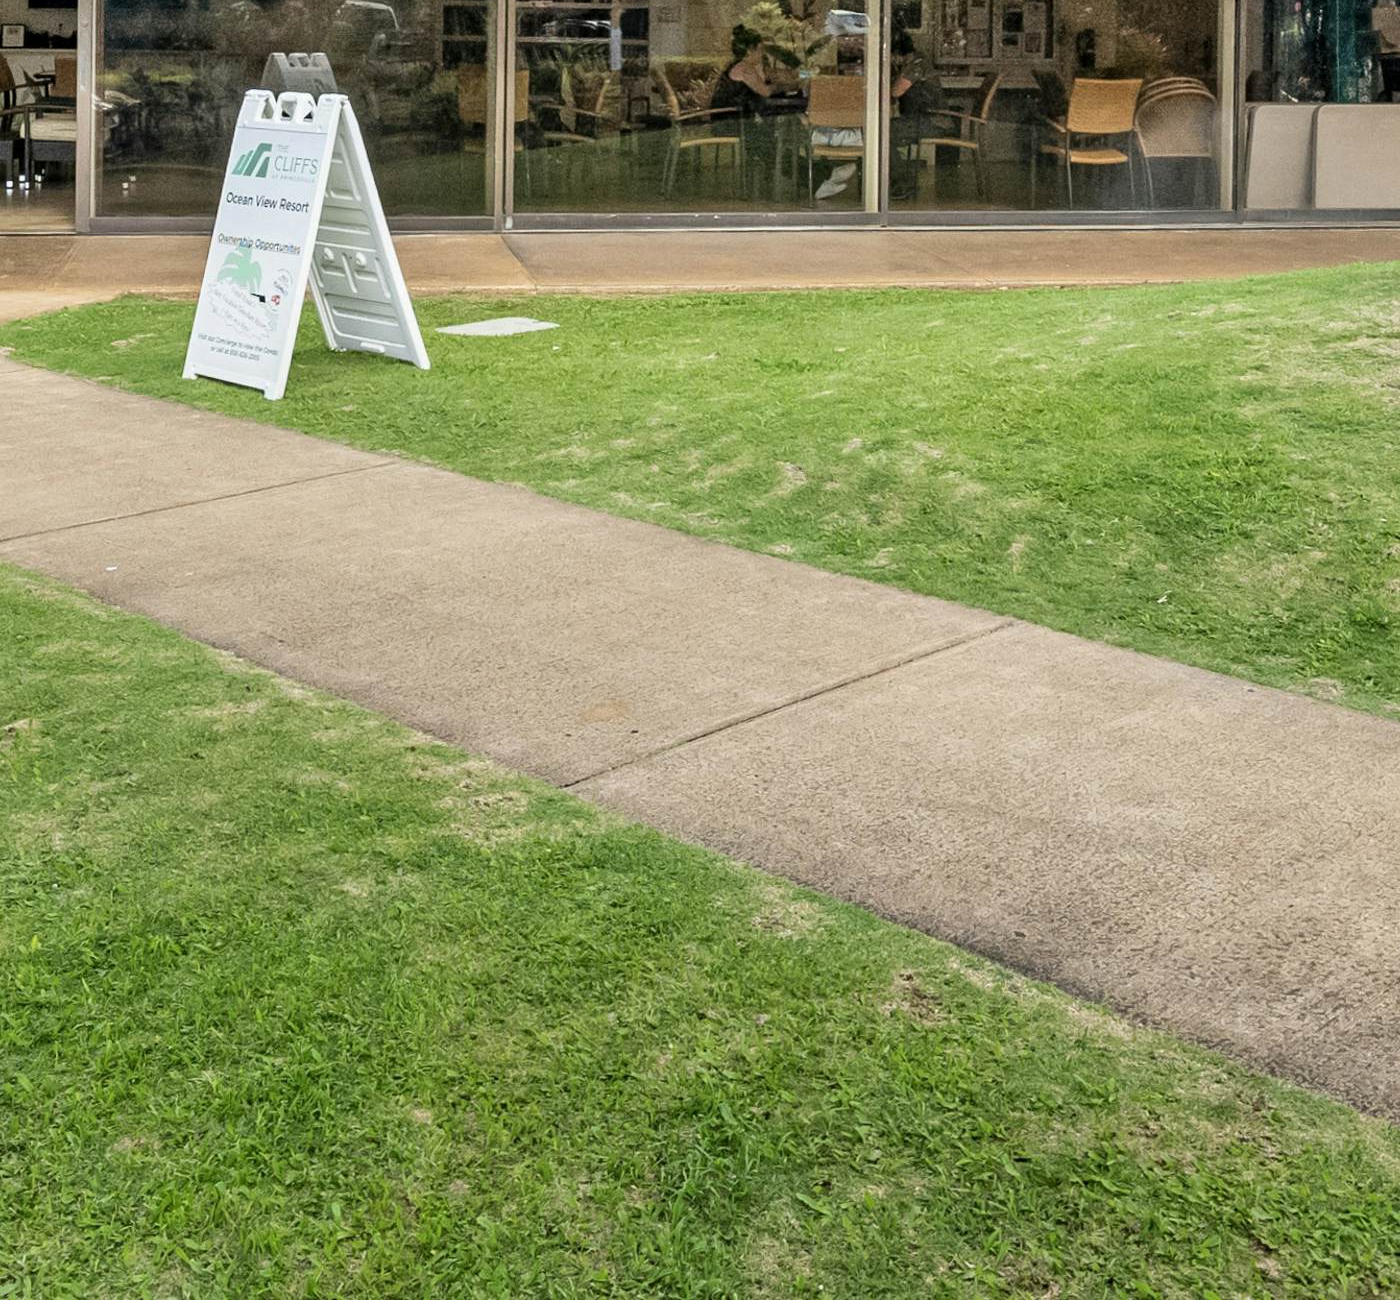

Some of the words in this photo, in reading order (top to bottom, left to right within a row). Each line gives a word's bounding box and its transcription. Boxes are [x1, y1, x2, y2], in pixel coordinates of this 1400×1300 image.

[274, 155, 319, 175] CLIFFS
[226, 191, 254, 206] Ocean
[256, 194, 278, 209] View
[279, 197, 310, 213] Resort
[218, 232, 254, 248] Ownership
